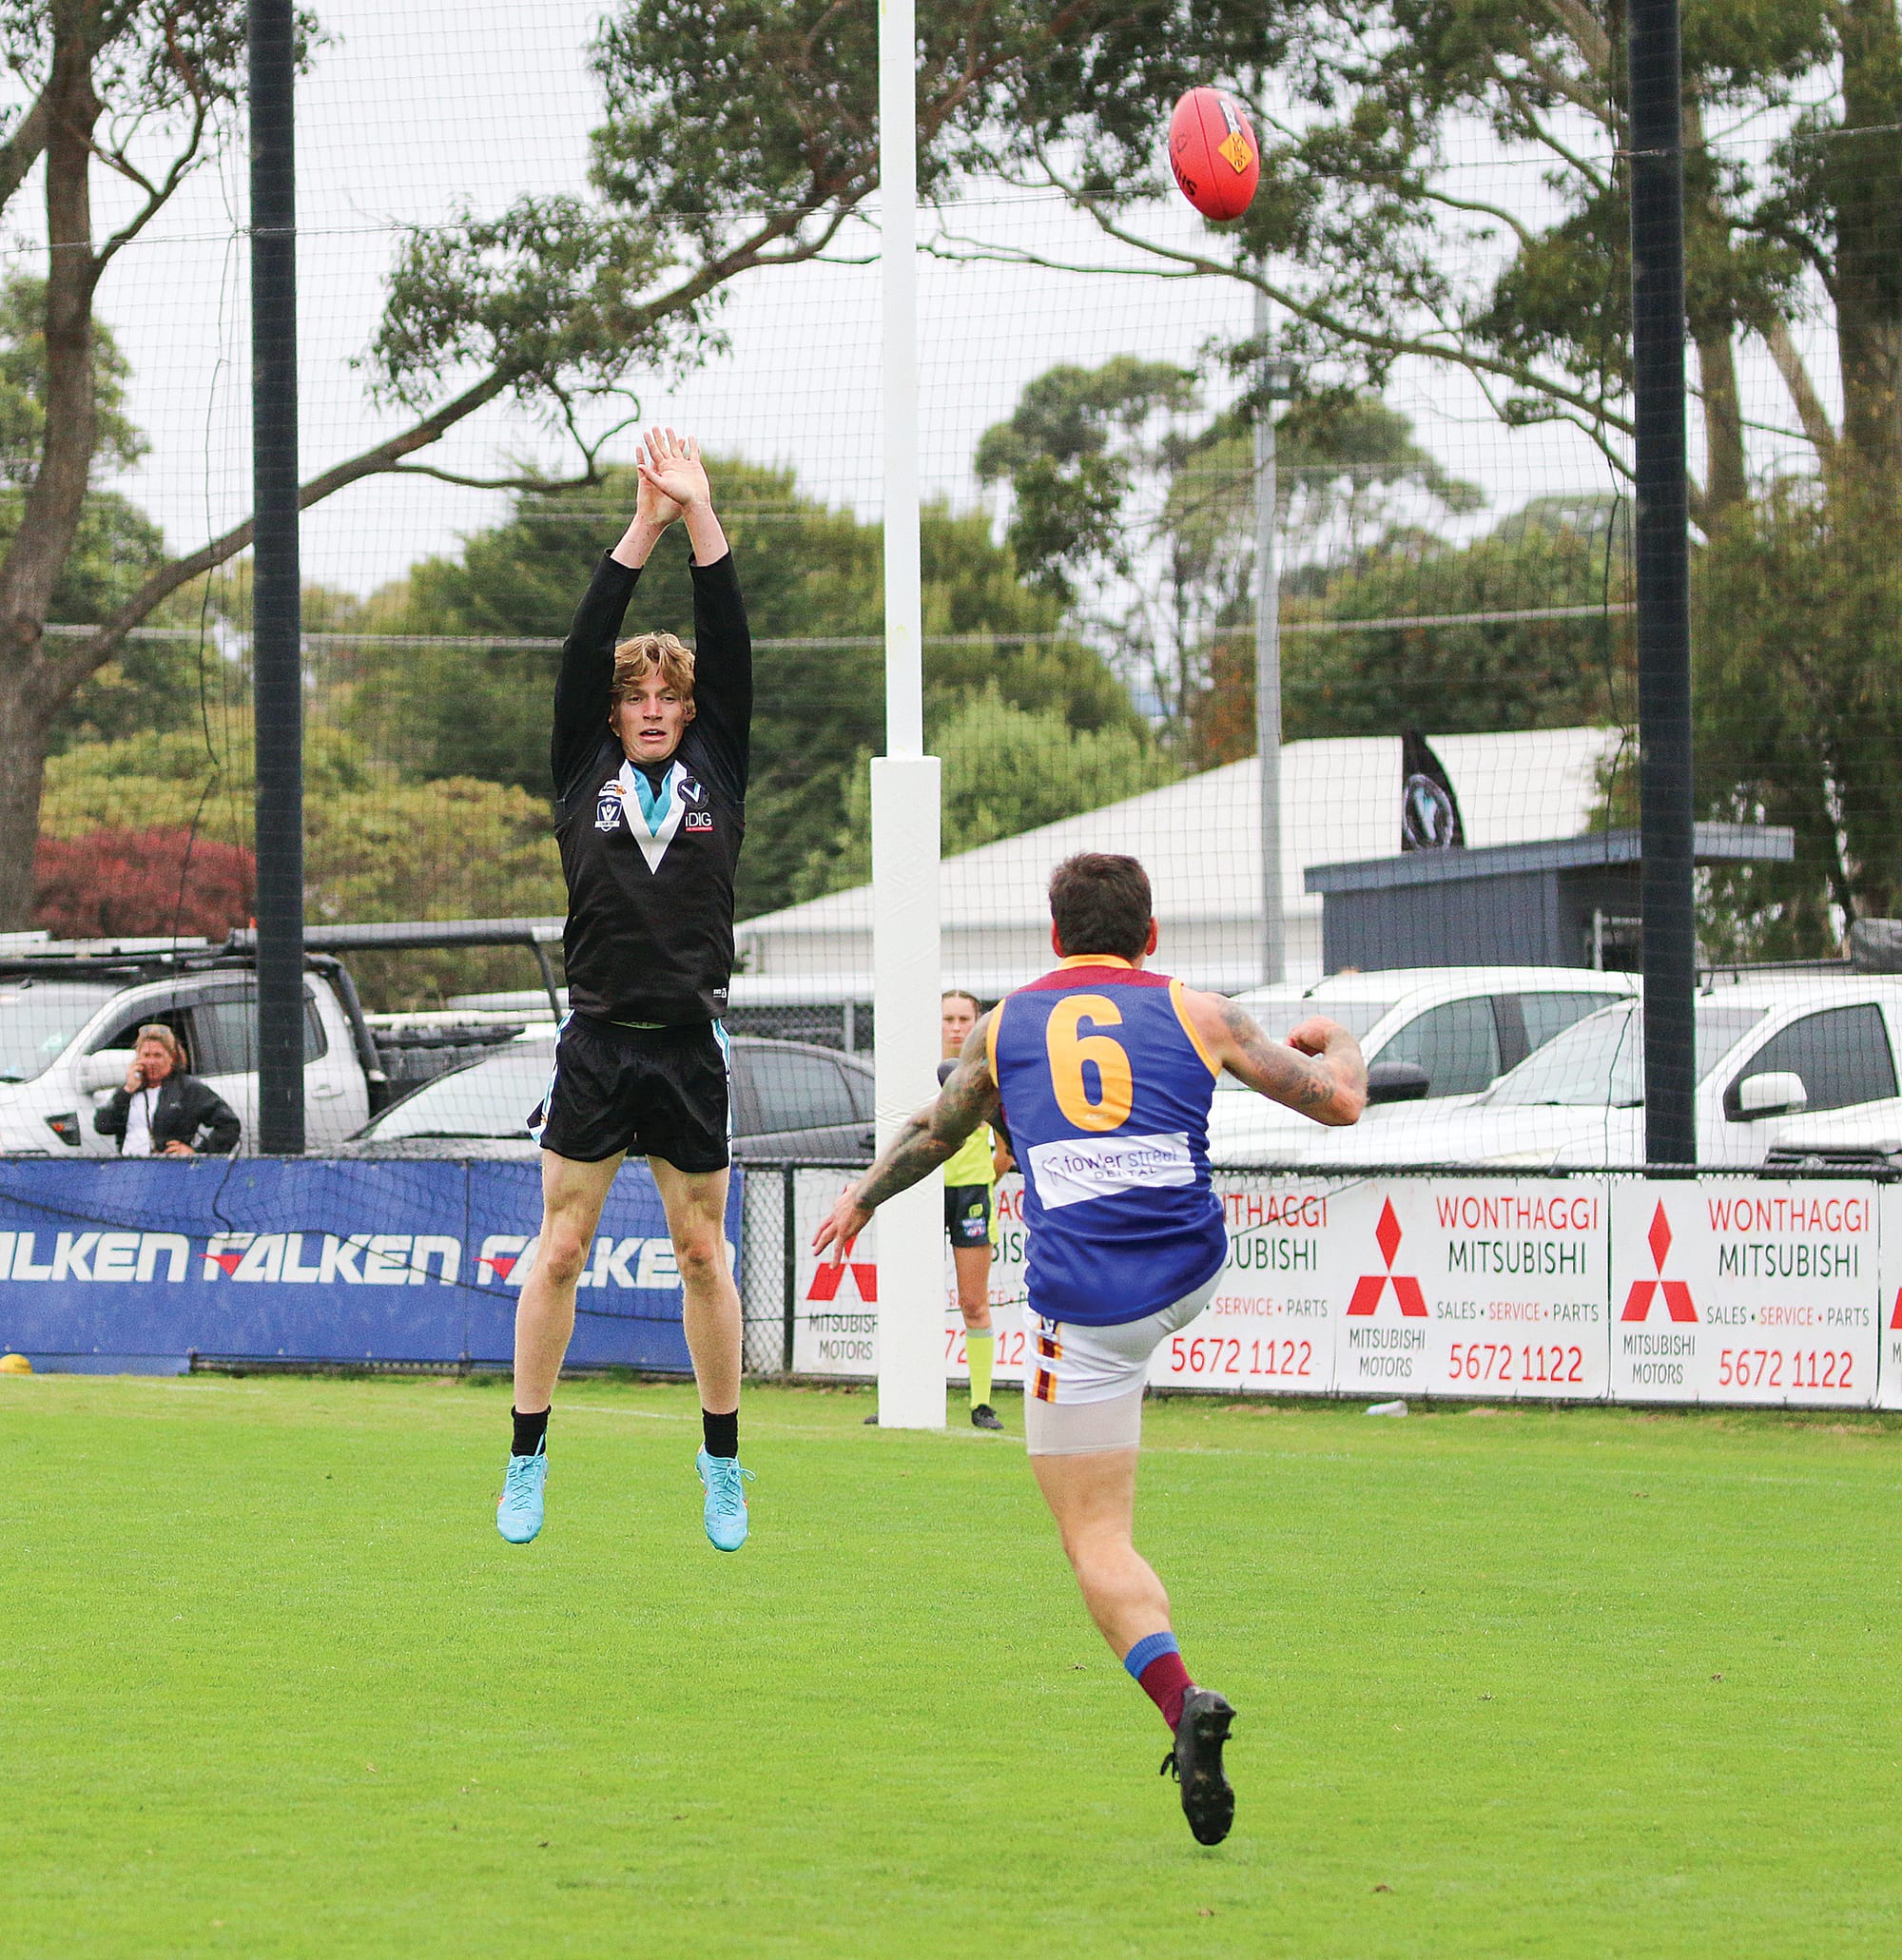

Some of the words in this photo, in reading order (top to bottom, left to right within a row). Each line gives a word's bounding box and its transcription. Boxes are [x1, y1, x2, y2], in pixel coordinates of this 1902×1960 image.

[685, 812, 712, 827] iDIG
[1045, 994, 1134, 1133] 6
[1436, 1195, 1599, 1231] WONTHAGGI
[1708, 1197, 1870, 1232] WONTHAGGI
[198, 1231, 462, 1286] FALKEN
[1448, 1239, 1586, 1274] MITSUBISHI
[1718, 1243, 1858, 1277] MITSUBISHI
[1215, 1296, 1274, 1316] SERVICE
[1286, 1298, 1328, 1317] PARTS
[1437, 1300, 1477, 1319] SALES
[1489, 1302, 1541, 1321] SERVICE
[1553, 1303, 1600, 1322] PARTS
[1707, 1306, 1747, 1325] SALES
[1760, 1307, 1814, 1326] SERVICE
[1827, 1308, 1871, 1327] PARTS
[819, 1340, 873, 1360] MOTORS
[1349, 1328, 1426, 1349] MITSUBISHI
[1622, 1333, 1697, 1356] MITSUBISHI
[1171, 1337, 1241, 1373] 5672
[1250, 1339, 1312, 1376] 1122
[1359, 1356, 1413, 1378] MOTORS
[1448, 1343, 1514, 1381] 5672
[1522, 1345, 1583, 1382] 1122
[1718, 1349, 1783, 1387] 5672
[1793, 1349, 1853, 1388] 1122
[1632, 1363, 1684, 1385] MOTORS
